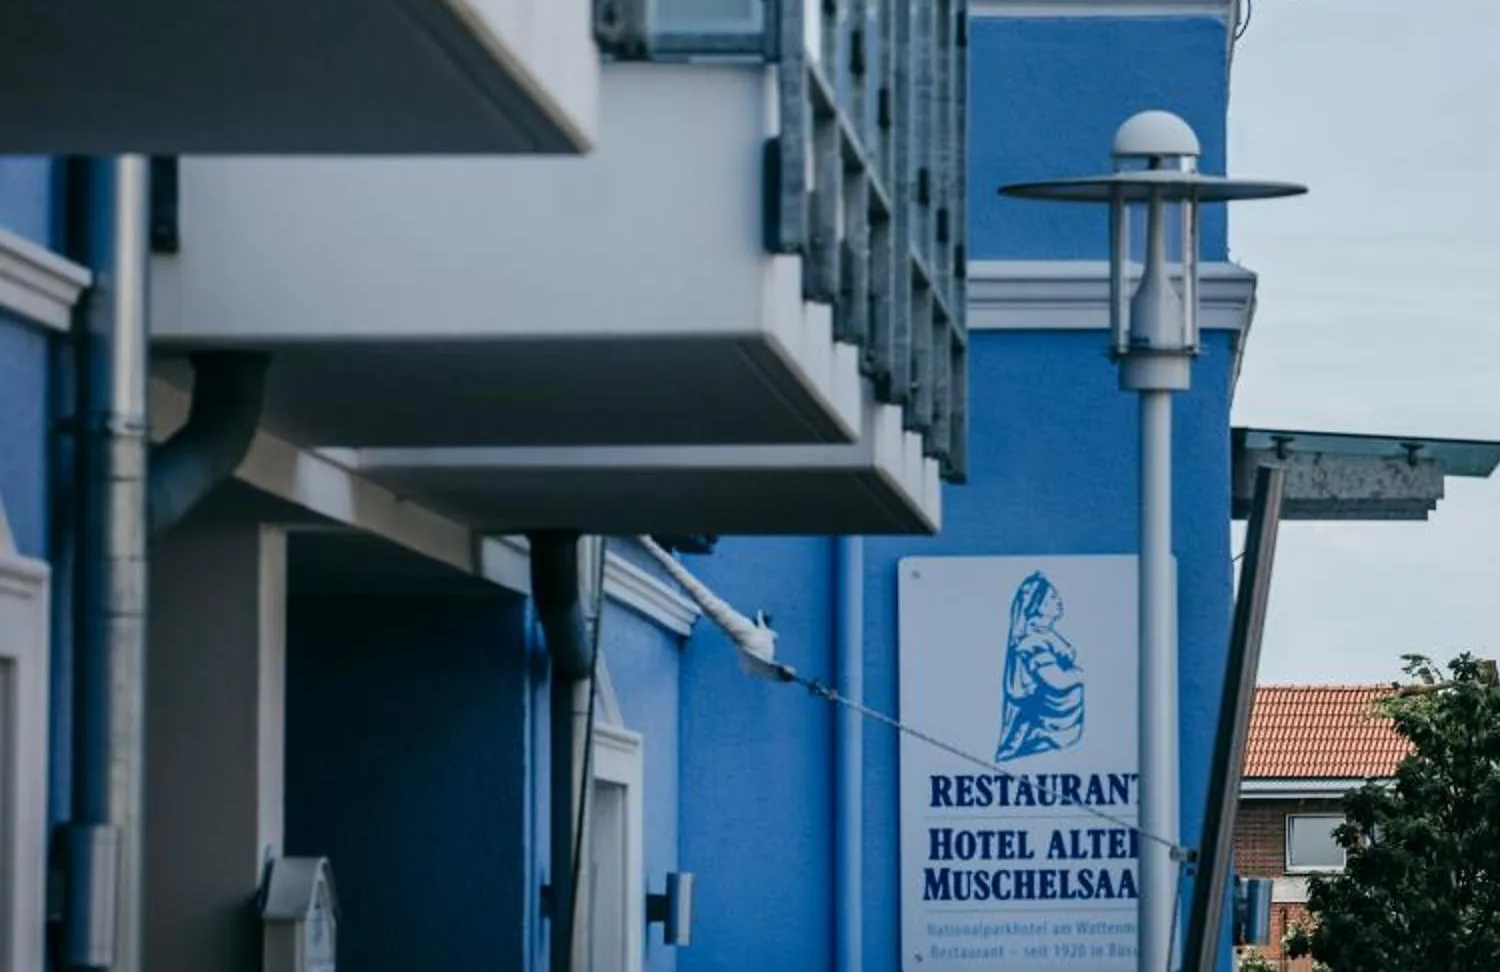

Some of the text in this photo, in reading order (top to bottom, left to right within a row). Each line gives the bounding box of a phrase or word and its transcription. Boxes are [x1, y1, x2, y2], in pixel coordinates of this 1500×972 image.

[928, 827, 1034, 860] HOTEL
[923, 867, 1139, 900] MUSCHELSAA
[1076, 920, 1138, 934] Wattenm
[931, 945, 1004, 958] Restaurant
